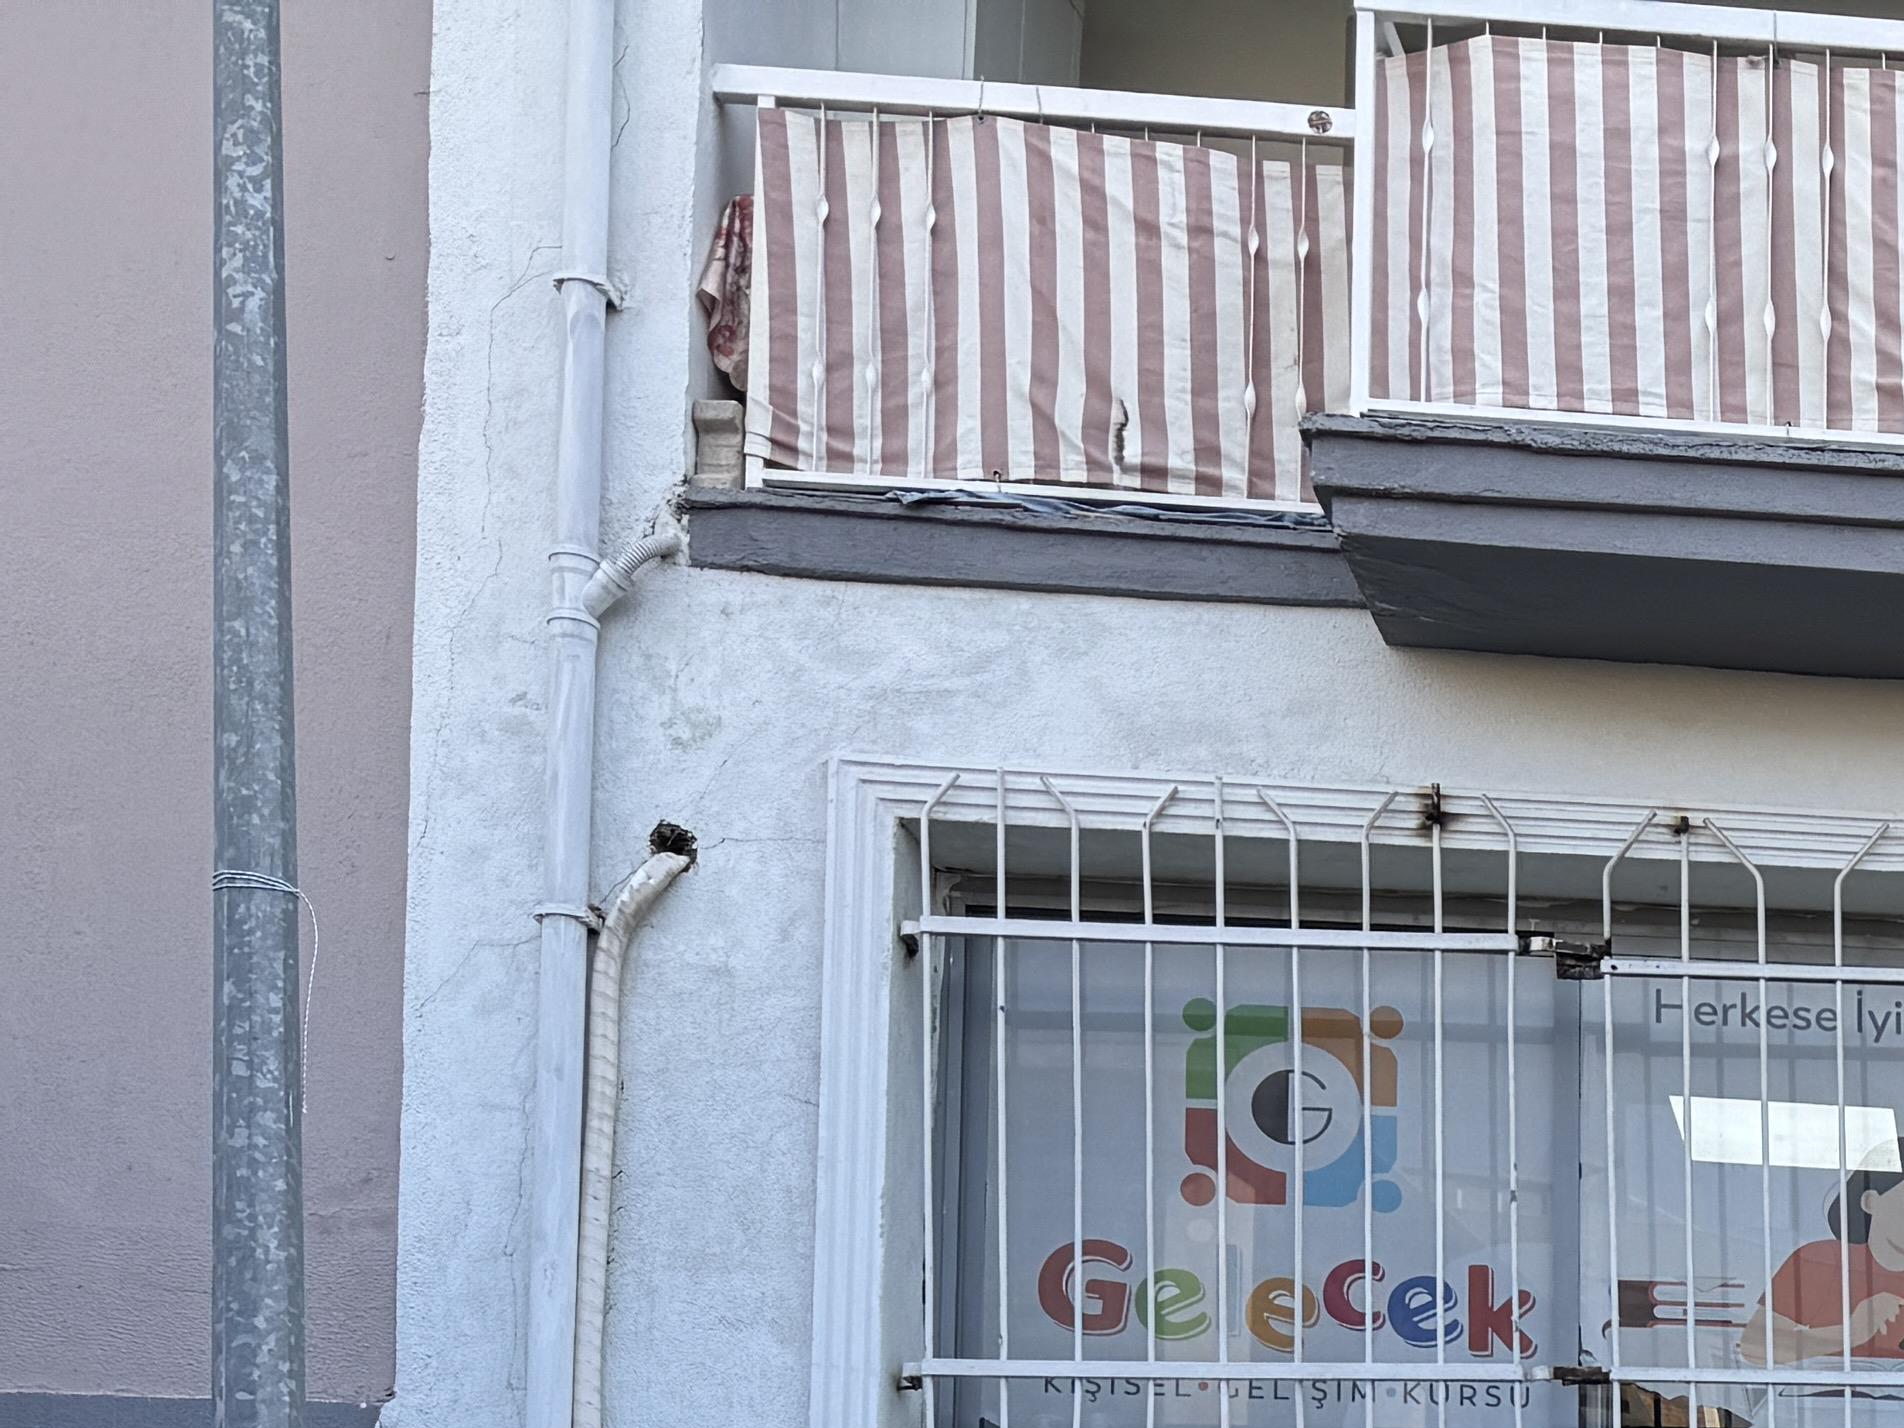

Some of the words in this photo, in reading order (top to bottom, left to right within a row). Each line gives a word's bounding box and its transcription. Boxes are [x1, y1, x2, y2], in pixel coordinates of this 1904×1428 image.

[1655, 989, 1839, 1032] Herkese
[1856, 990, 1903, 1043] İyi
[1403, 1382, 1530, 1408] KURSU
